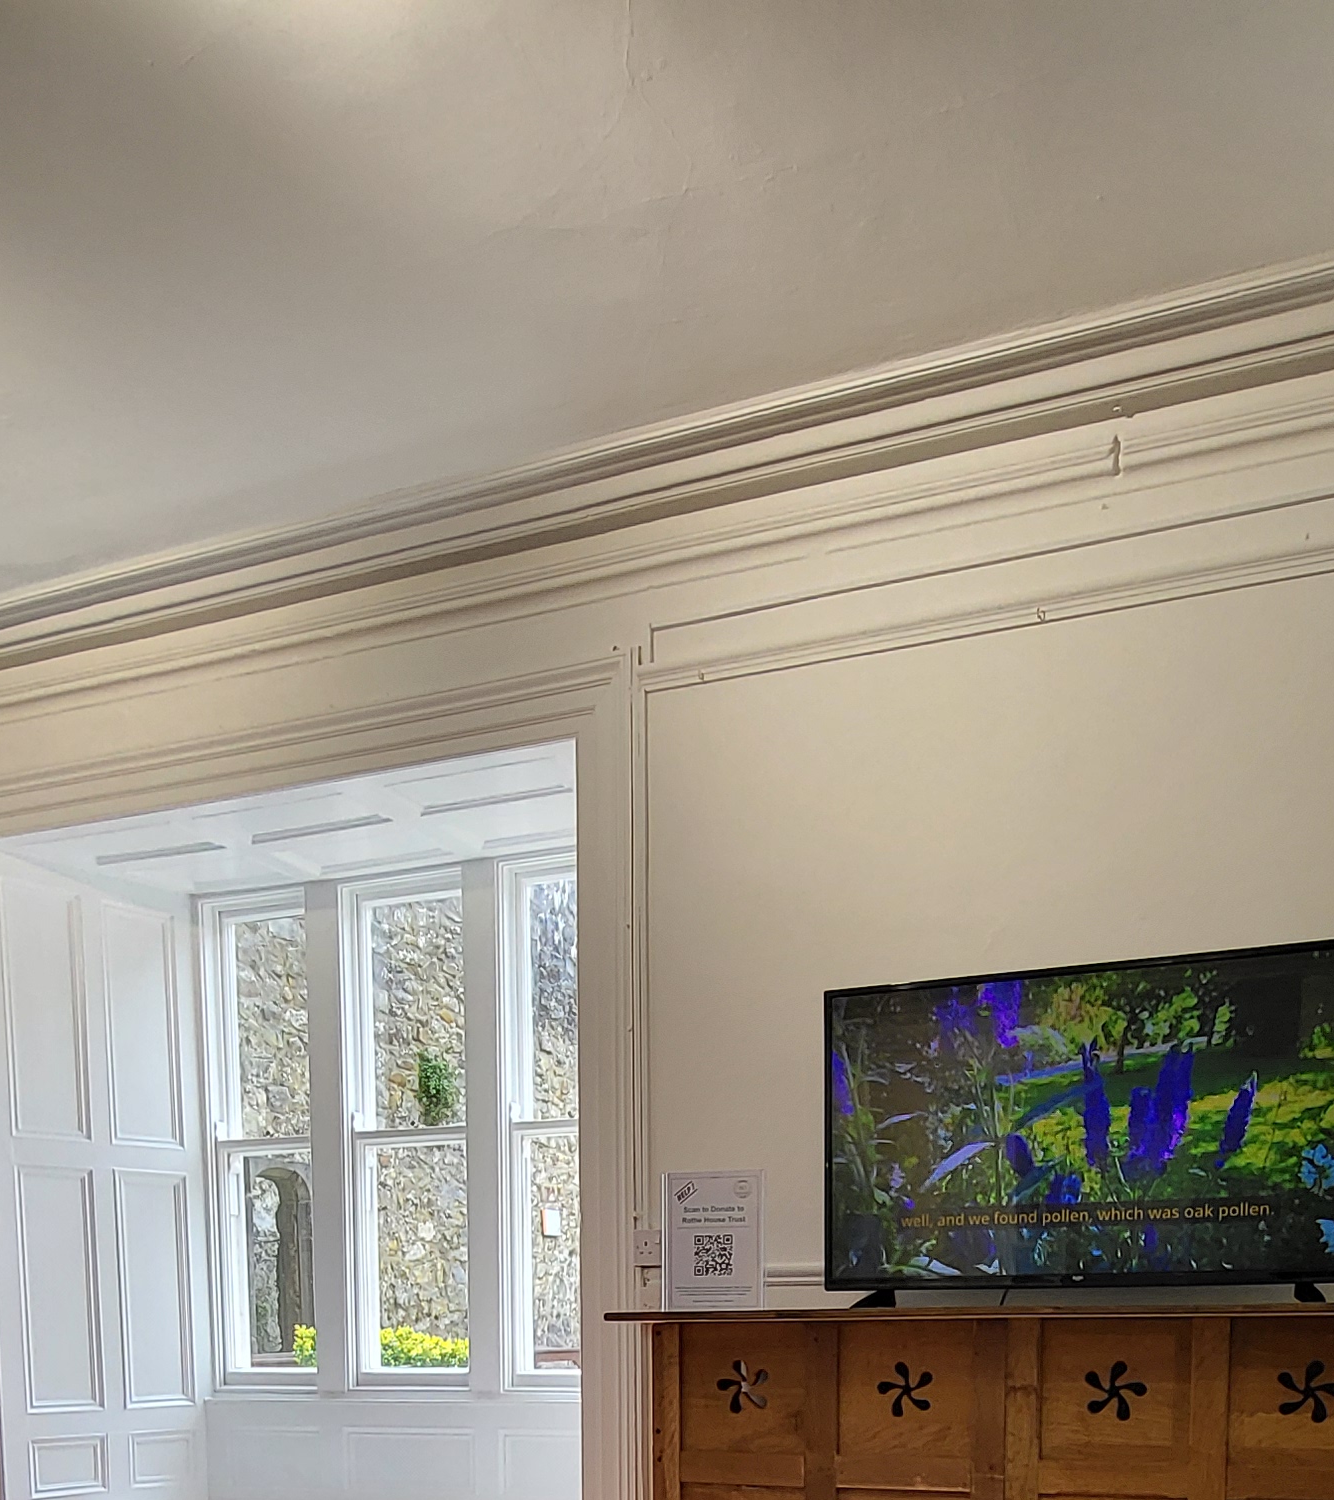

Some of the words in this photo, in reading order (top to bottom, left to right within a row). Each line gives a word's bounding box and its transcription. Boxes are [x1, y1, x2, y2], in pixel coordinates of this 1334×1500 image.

[900, 1213, 934, 1228] well,
[938, 1212, 964, 1226] and
[968, 1214, 990, 1225] we
[993, 1210, 1037, 1224] found
[1041, 1208, 1092, 1226] pollen,
[1097, 1206, 1144, 1222] which
[1148, 1208, 1179, 1220] was
[1184, 1204, 1213, 1219] oak
[1218, 1200, 1275, 1221] pollen.
